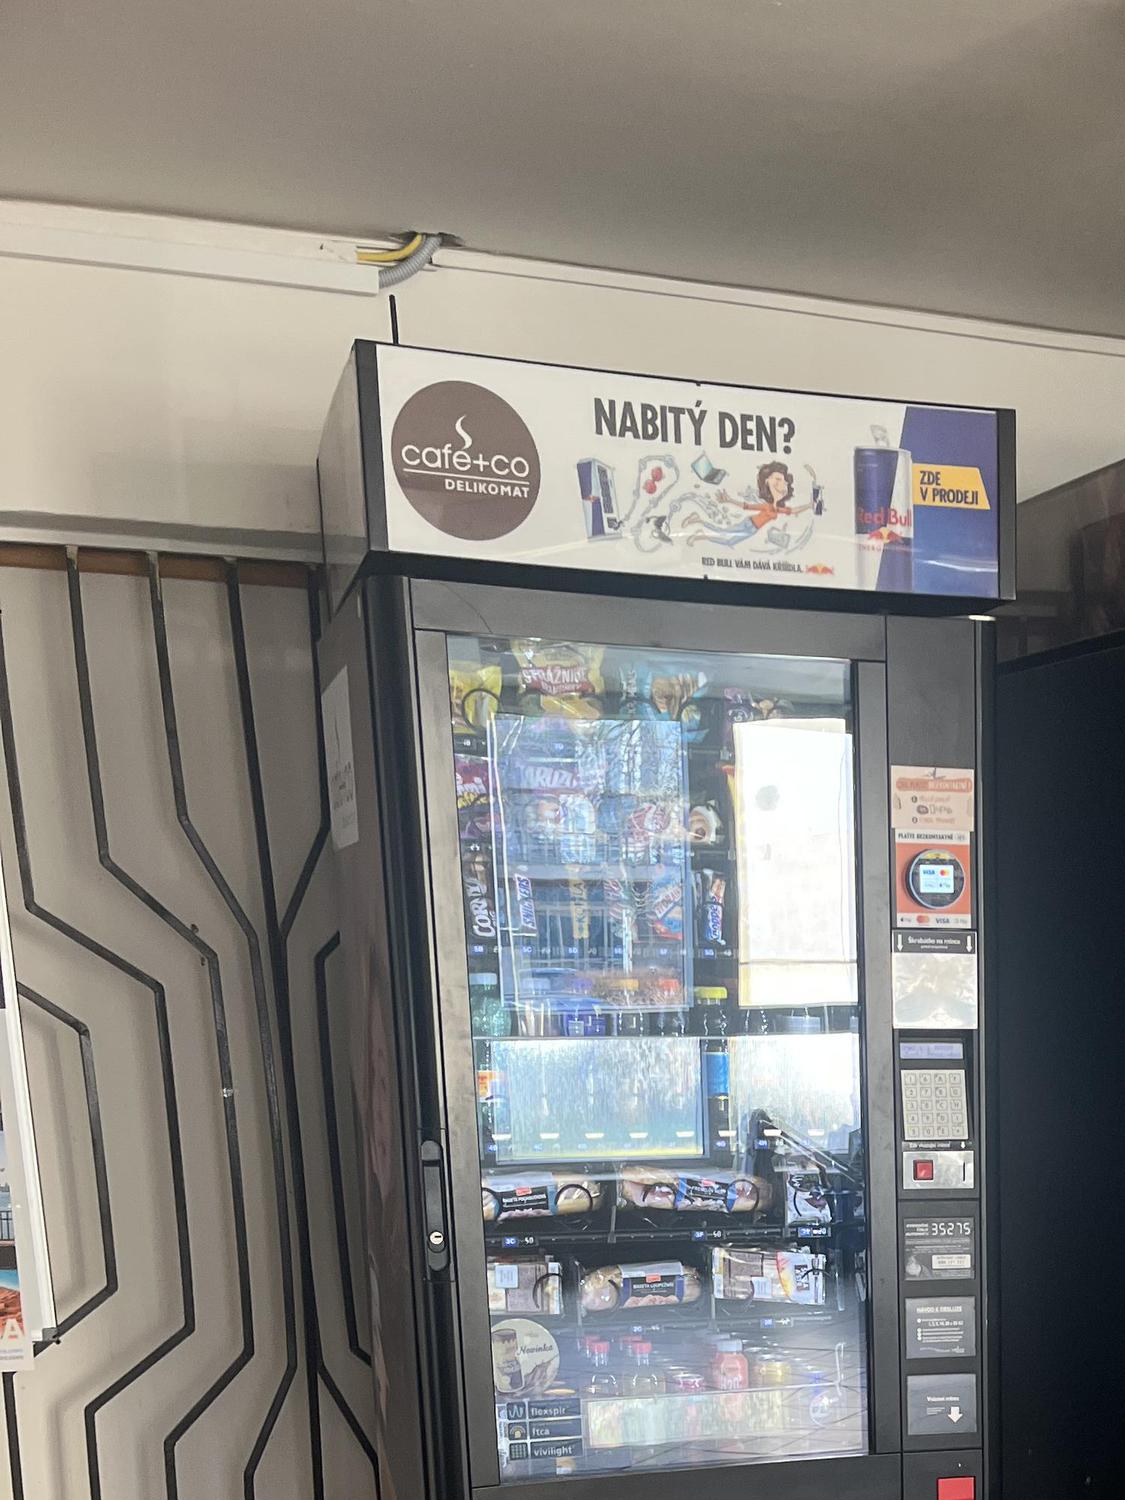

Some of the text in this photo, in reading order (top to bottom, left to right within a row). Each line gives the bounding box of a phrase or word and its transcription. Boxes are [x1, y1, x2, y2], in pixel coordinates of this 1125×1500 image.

[594, 397, 796, 455] NABITÝ DEN?
[919, 470, 941, 486] ZDE
[445, 478, 530, 498] DELIKOMAT
[919, 486, 979, 505] V PRODEJI
[931, 1222, 971, 1236] 35275
[533, 1446, 573, 1458] vivilight
